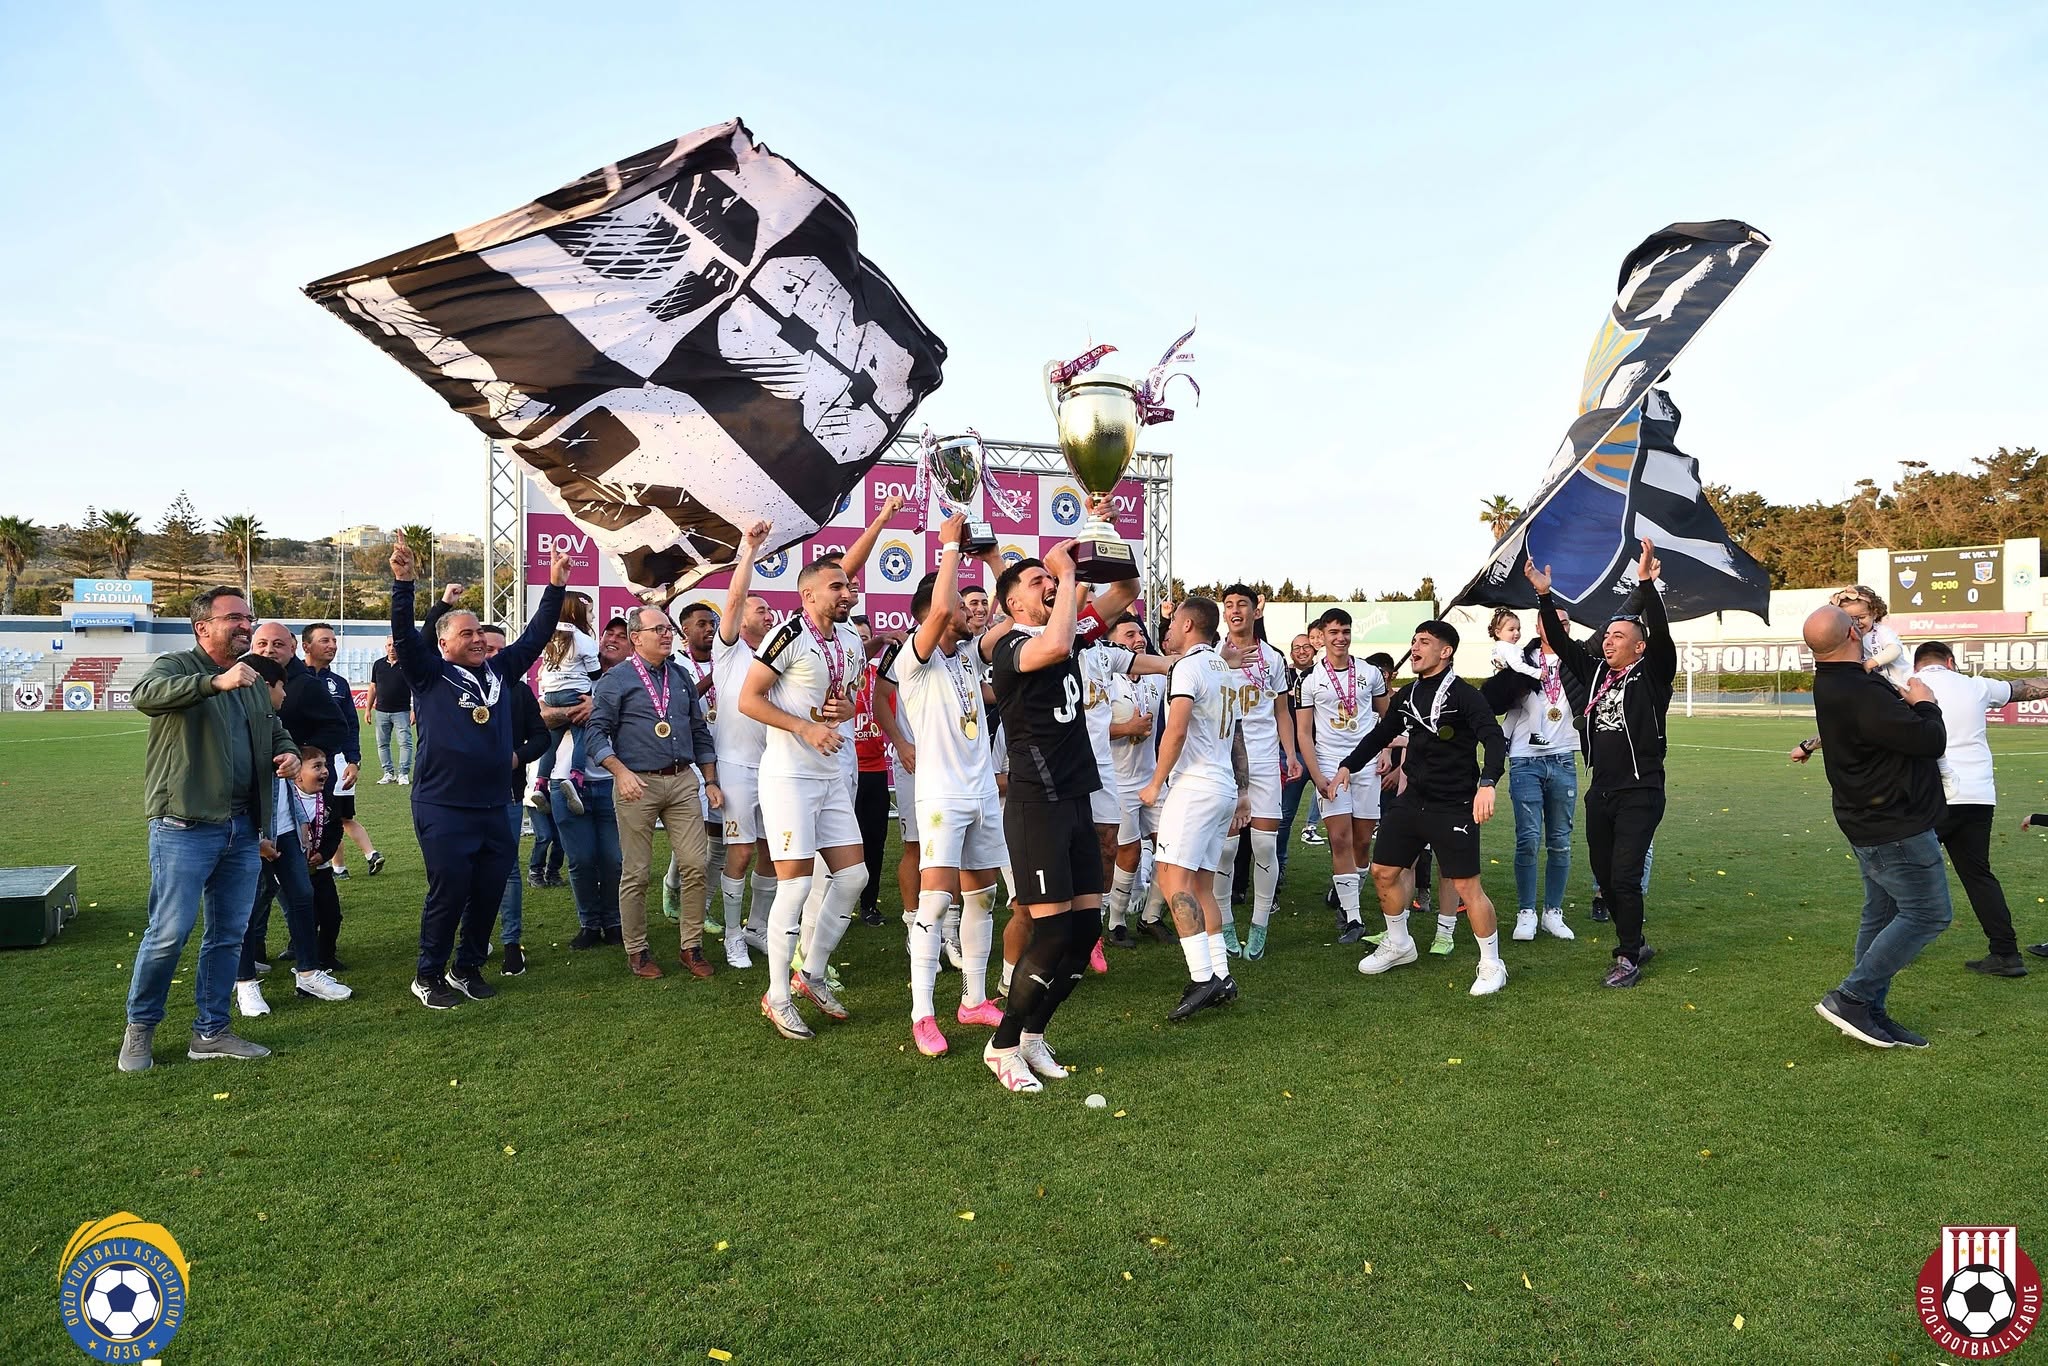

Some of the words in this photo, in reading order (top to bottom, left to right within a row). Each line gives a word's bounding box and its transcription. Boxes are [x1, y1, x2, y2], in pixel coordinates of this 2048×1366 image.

[874, 482, 917, 500] BOV
[1112, 496, 1137, 512] OV
[538, 533, 588, 553] BOV
[1894, 556, 1921, 564] NADUR
[95, 582, 132, 592] GOZO
[1931, 580, 1958, 590] 90:00
[83, 592, 143, 603] STADIUM
[1911, 592, 1923, 605] 4
[1967, 588, 1979, 602] 0
[874, 611, 915, 629] BOV
[1910, 620, 1934, 630] BOV
[113, 693, 131, 703] BO
[725, 821, 739, 837] 22
[783, 831, 792, 851] 7
[1036, 869, 1046, 895] 1
